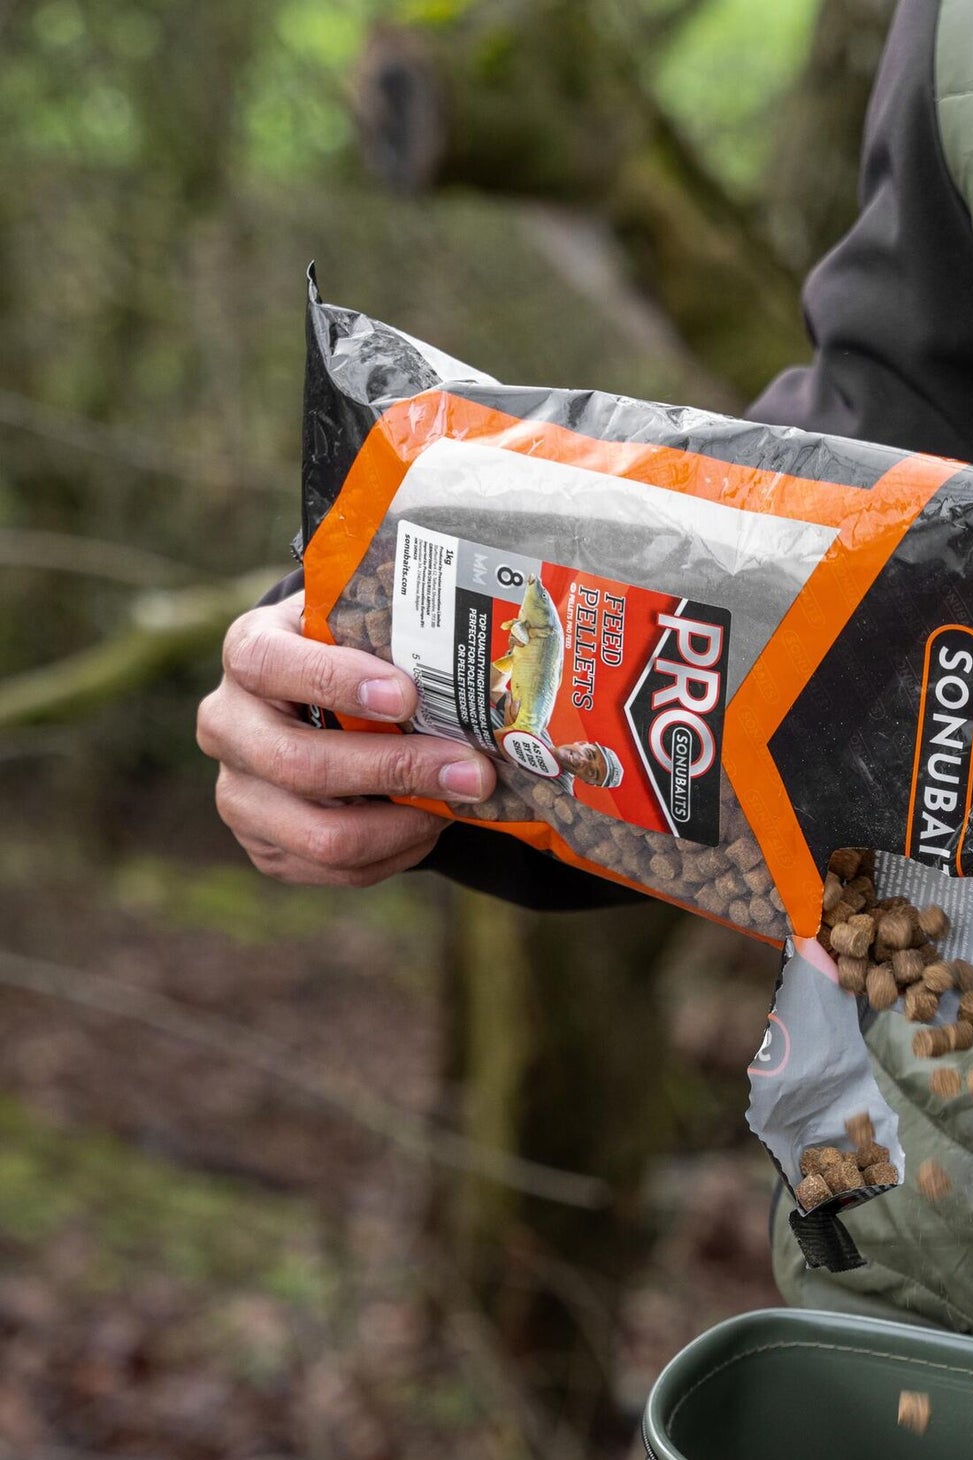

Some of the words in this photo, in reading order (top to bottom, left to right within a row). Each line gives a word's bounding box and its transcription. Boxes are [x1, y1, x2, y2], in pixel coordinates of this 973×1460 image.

[401, 534, 411, 596] sonubaits.com
[444, 549, 454, 565] 1kg
[473, 553, 488, 585] MM
[496, 566, 524, 587] 8
[468, 608, 477, 646] PERFECT
[479, 613, 487, 631] TOP
[601, 592, 626, 667] FEED
[458, 644, 466, 658] OR
[468, 646, 476, 664] FOR
[477, 631, 486, 669] QUALITY
[572, 585, 600, 710] PELLETS
[458, 658, 466, 687] PELLET
[467, 665, 475, 687] POLE
[477, 670, 485, 692] HIGH
[467, 687, 478, 718] FISHING
[477, 692, 488, 729] FISHMEAL
[648, 613, 724, 778] PRO
[522, 741, 532, 754] BY
[532, 742, 541, 754] AS
[918, 645, 973, 877] SONUBAI
[673, 734, 688, 816] SONUBAITS
